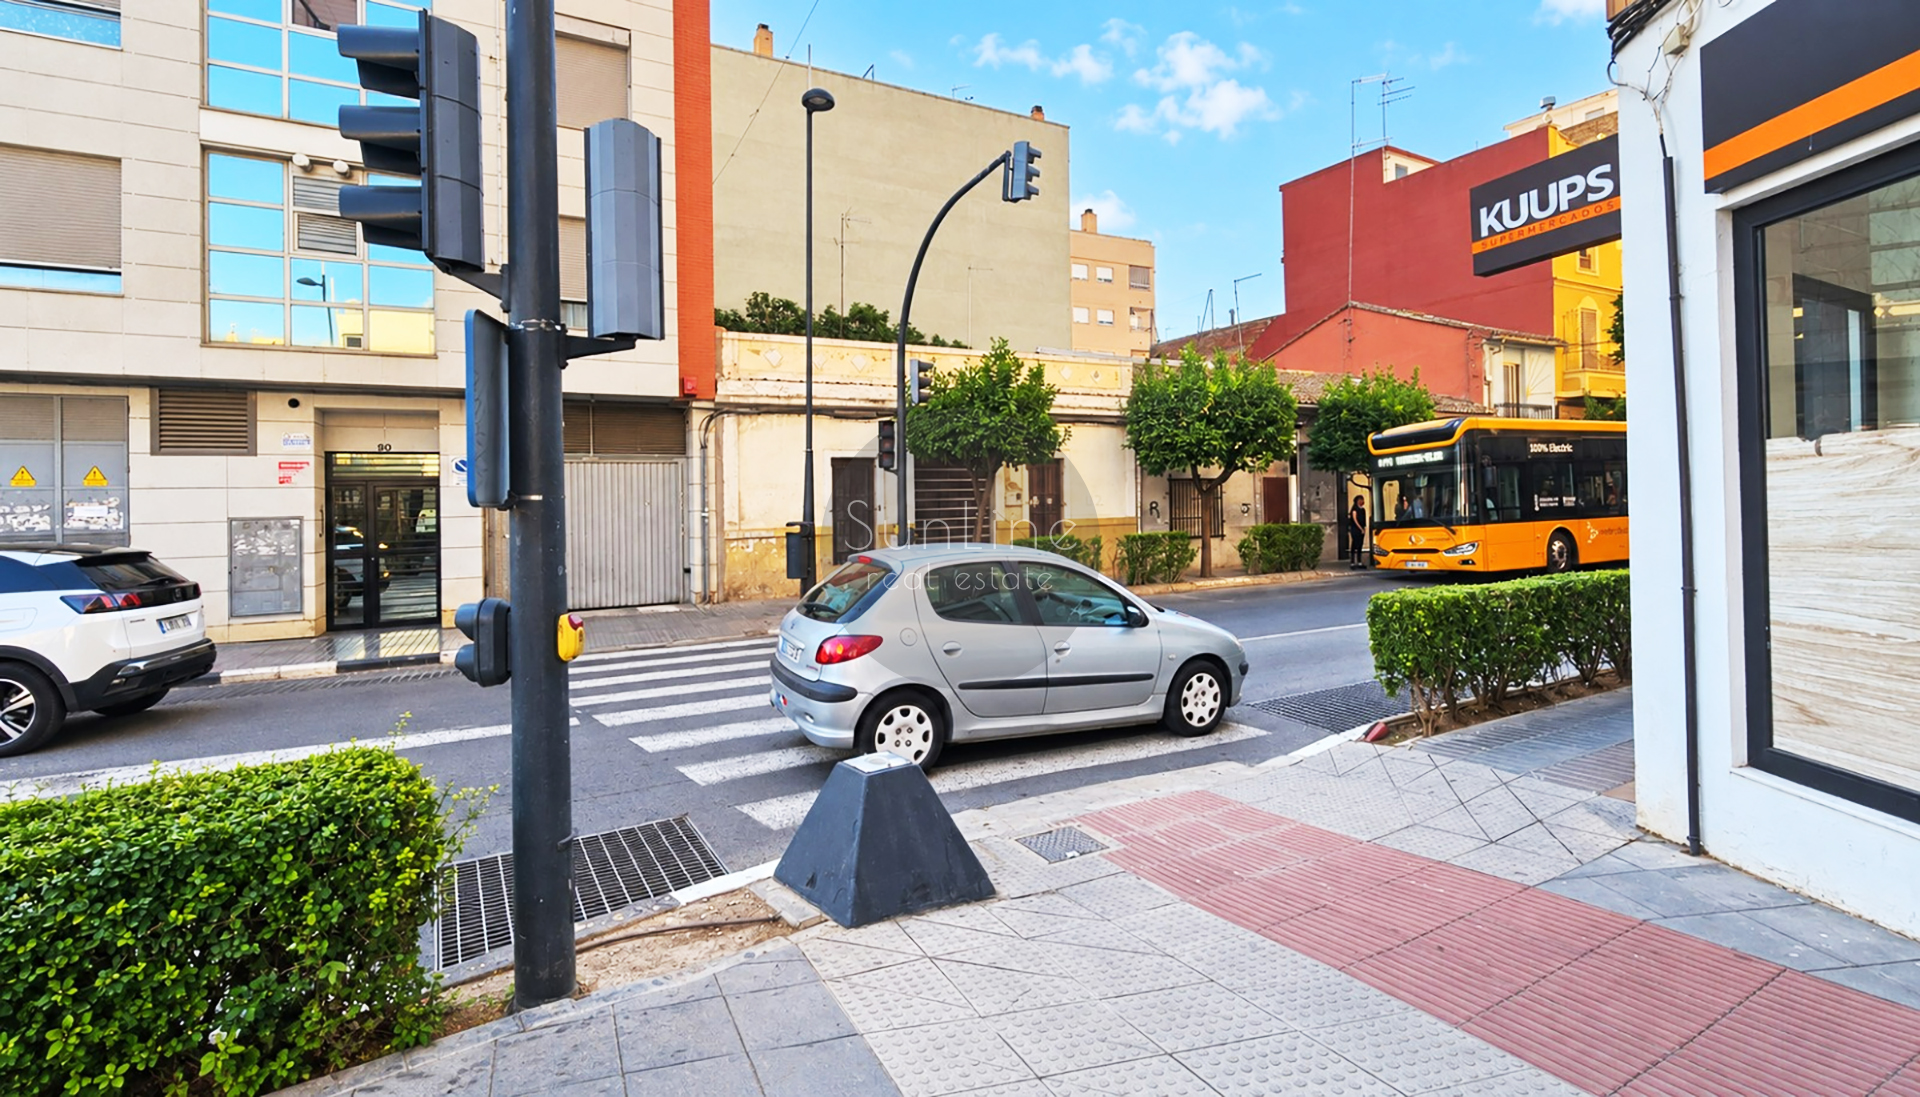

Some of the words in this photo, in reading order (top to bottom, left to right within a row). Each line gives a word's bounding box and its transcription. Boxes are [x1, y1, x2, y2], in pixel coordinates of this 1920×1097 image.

[1480, 164, 1614, 238] KUUPS
[1481, 202, 1615, 249] SUPERMERCADOS
[1529, 443, 1548, 453] 100%
[1548, 443, 1573, 453] Electric
